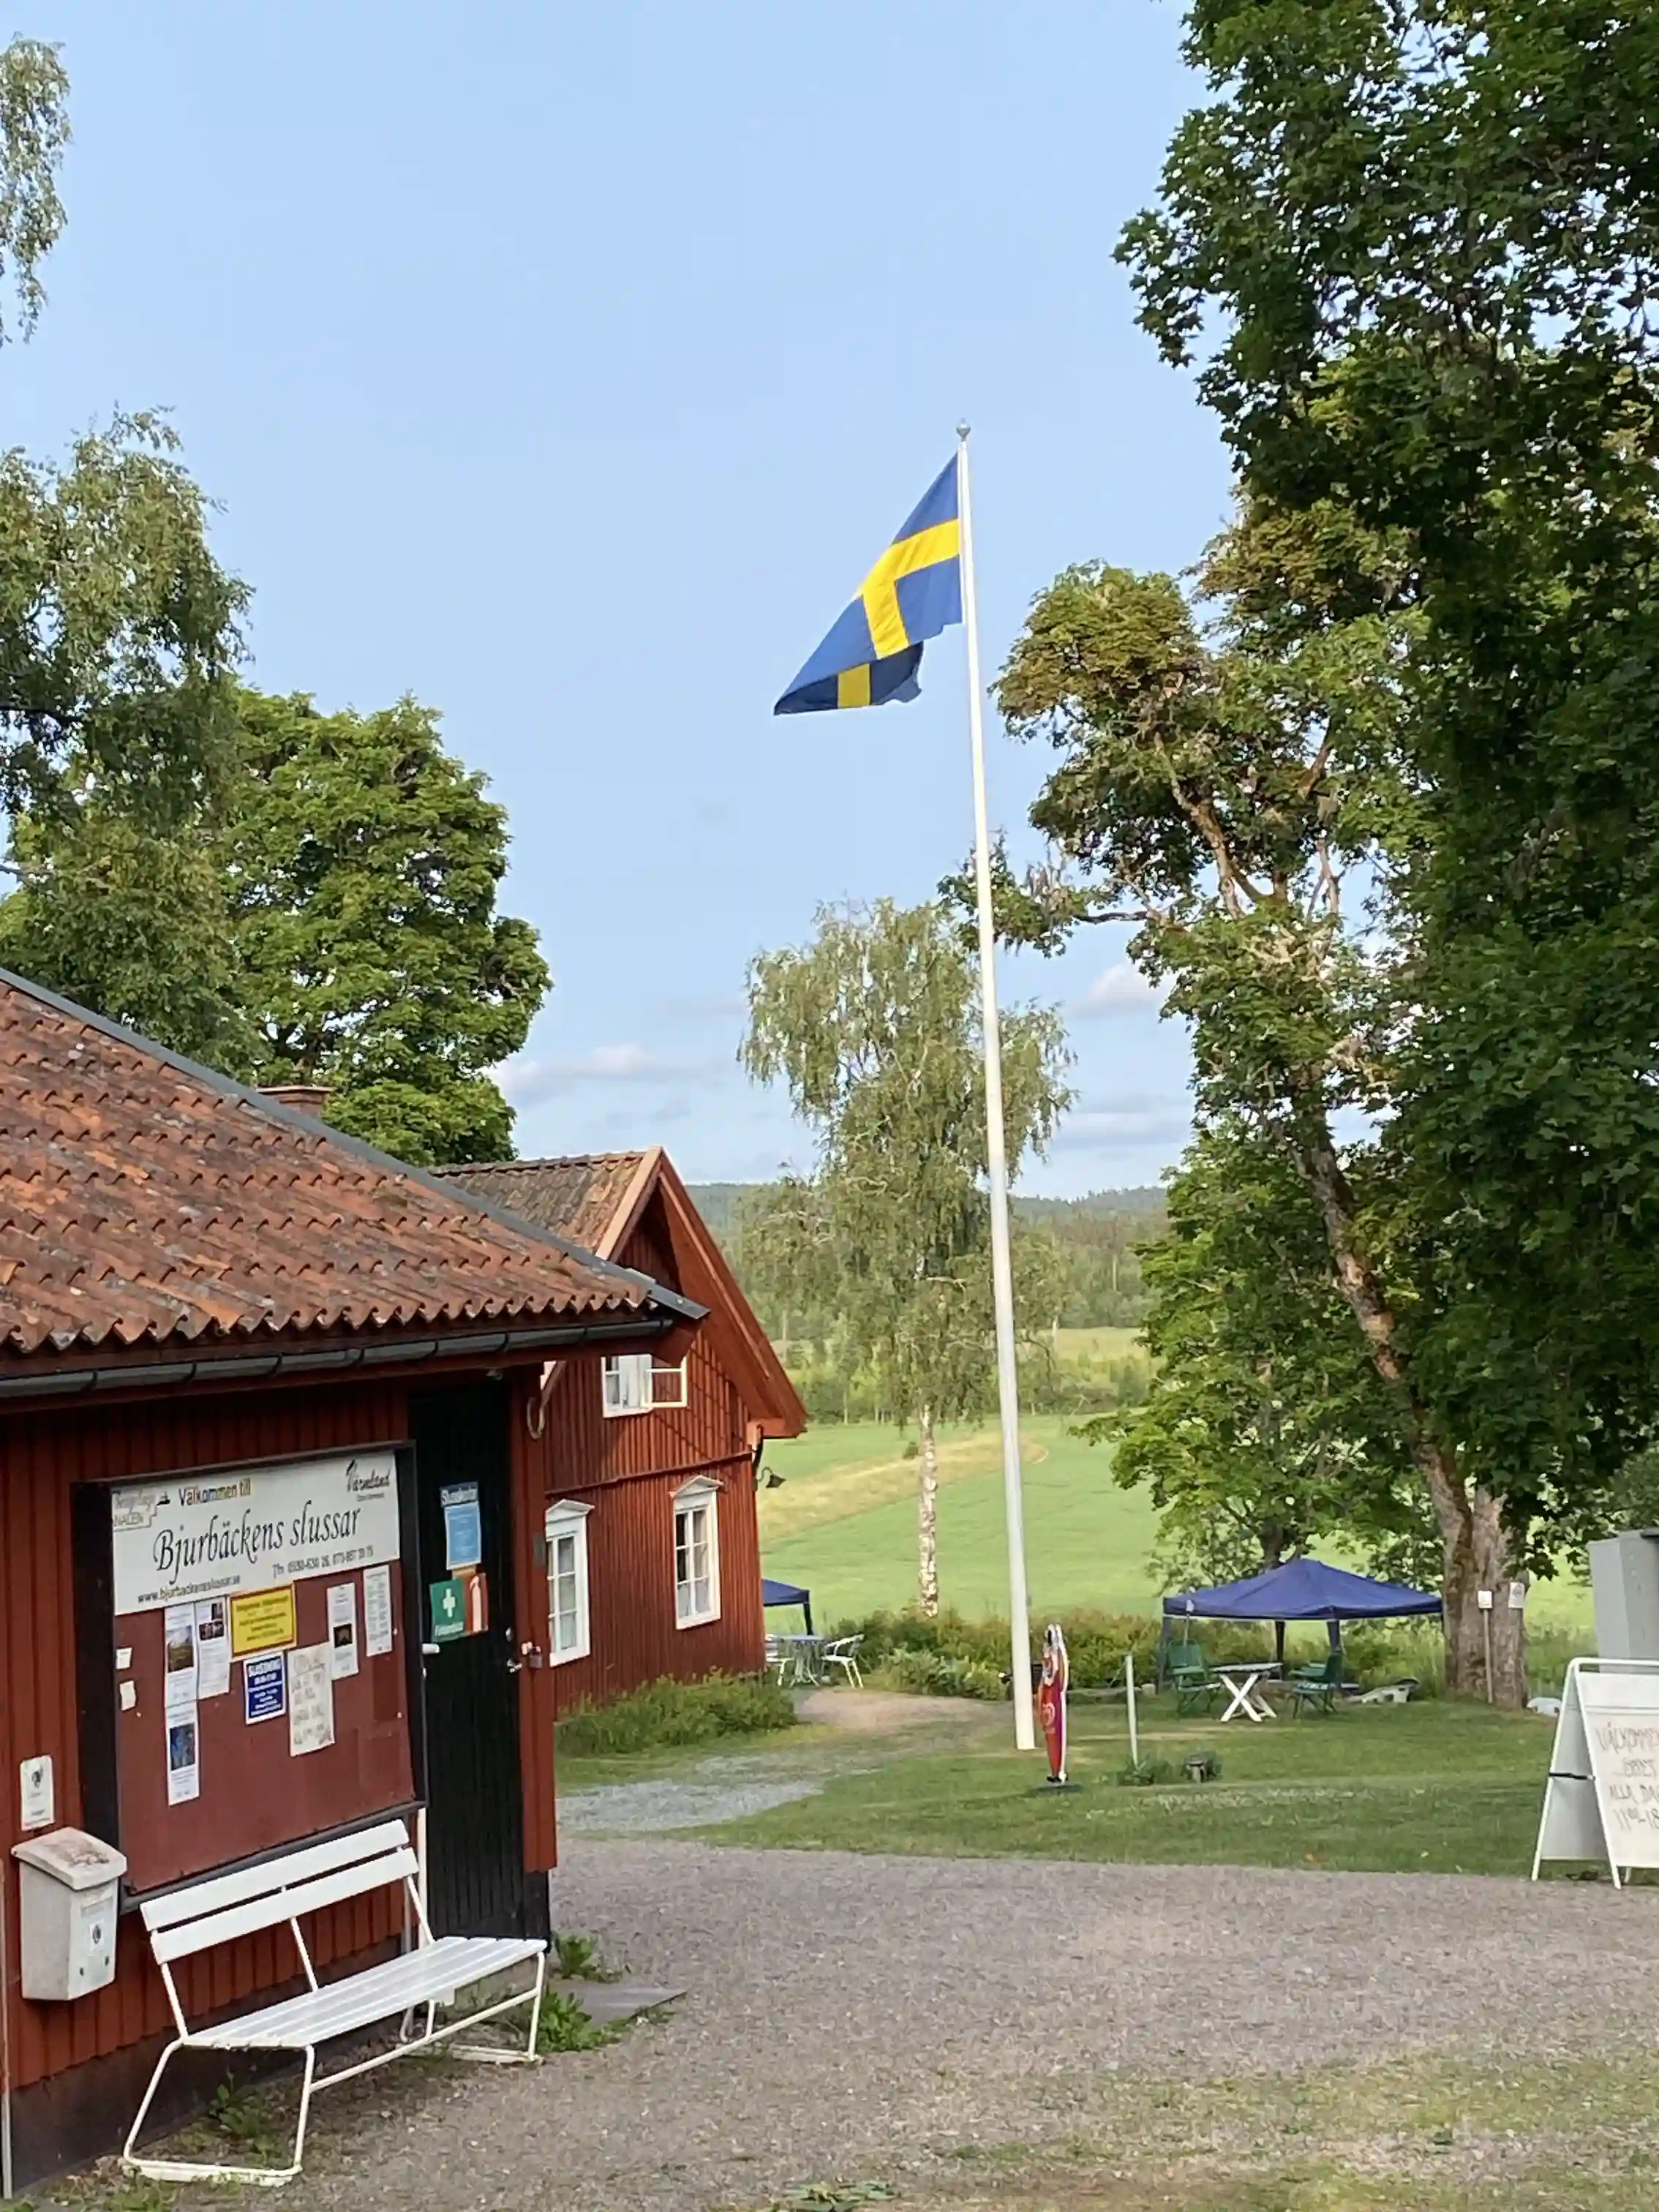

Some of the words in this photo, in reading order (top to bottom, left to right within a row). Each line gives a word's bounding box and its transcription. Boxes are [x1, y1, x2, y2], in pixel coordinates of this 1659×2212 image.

[178, 1483, 237, 1507] Välkommen
[239, 1477, 252, 1497] till
[153, 1508, 285, 1585] Bjurbäckens
[290, 1500, 362, 1546] slussar
[1595, 1721, 1659, 1755] VÄLKOMME
